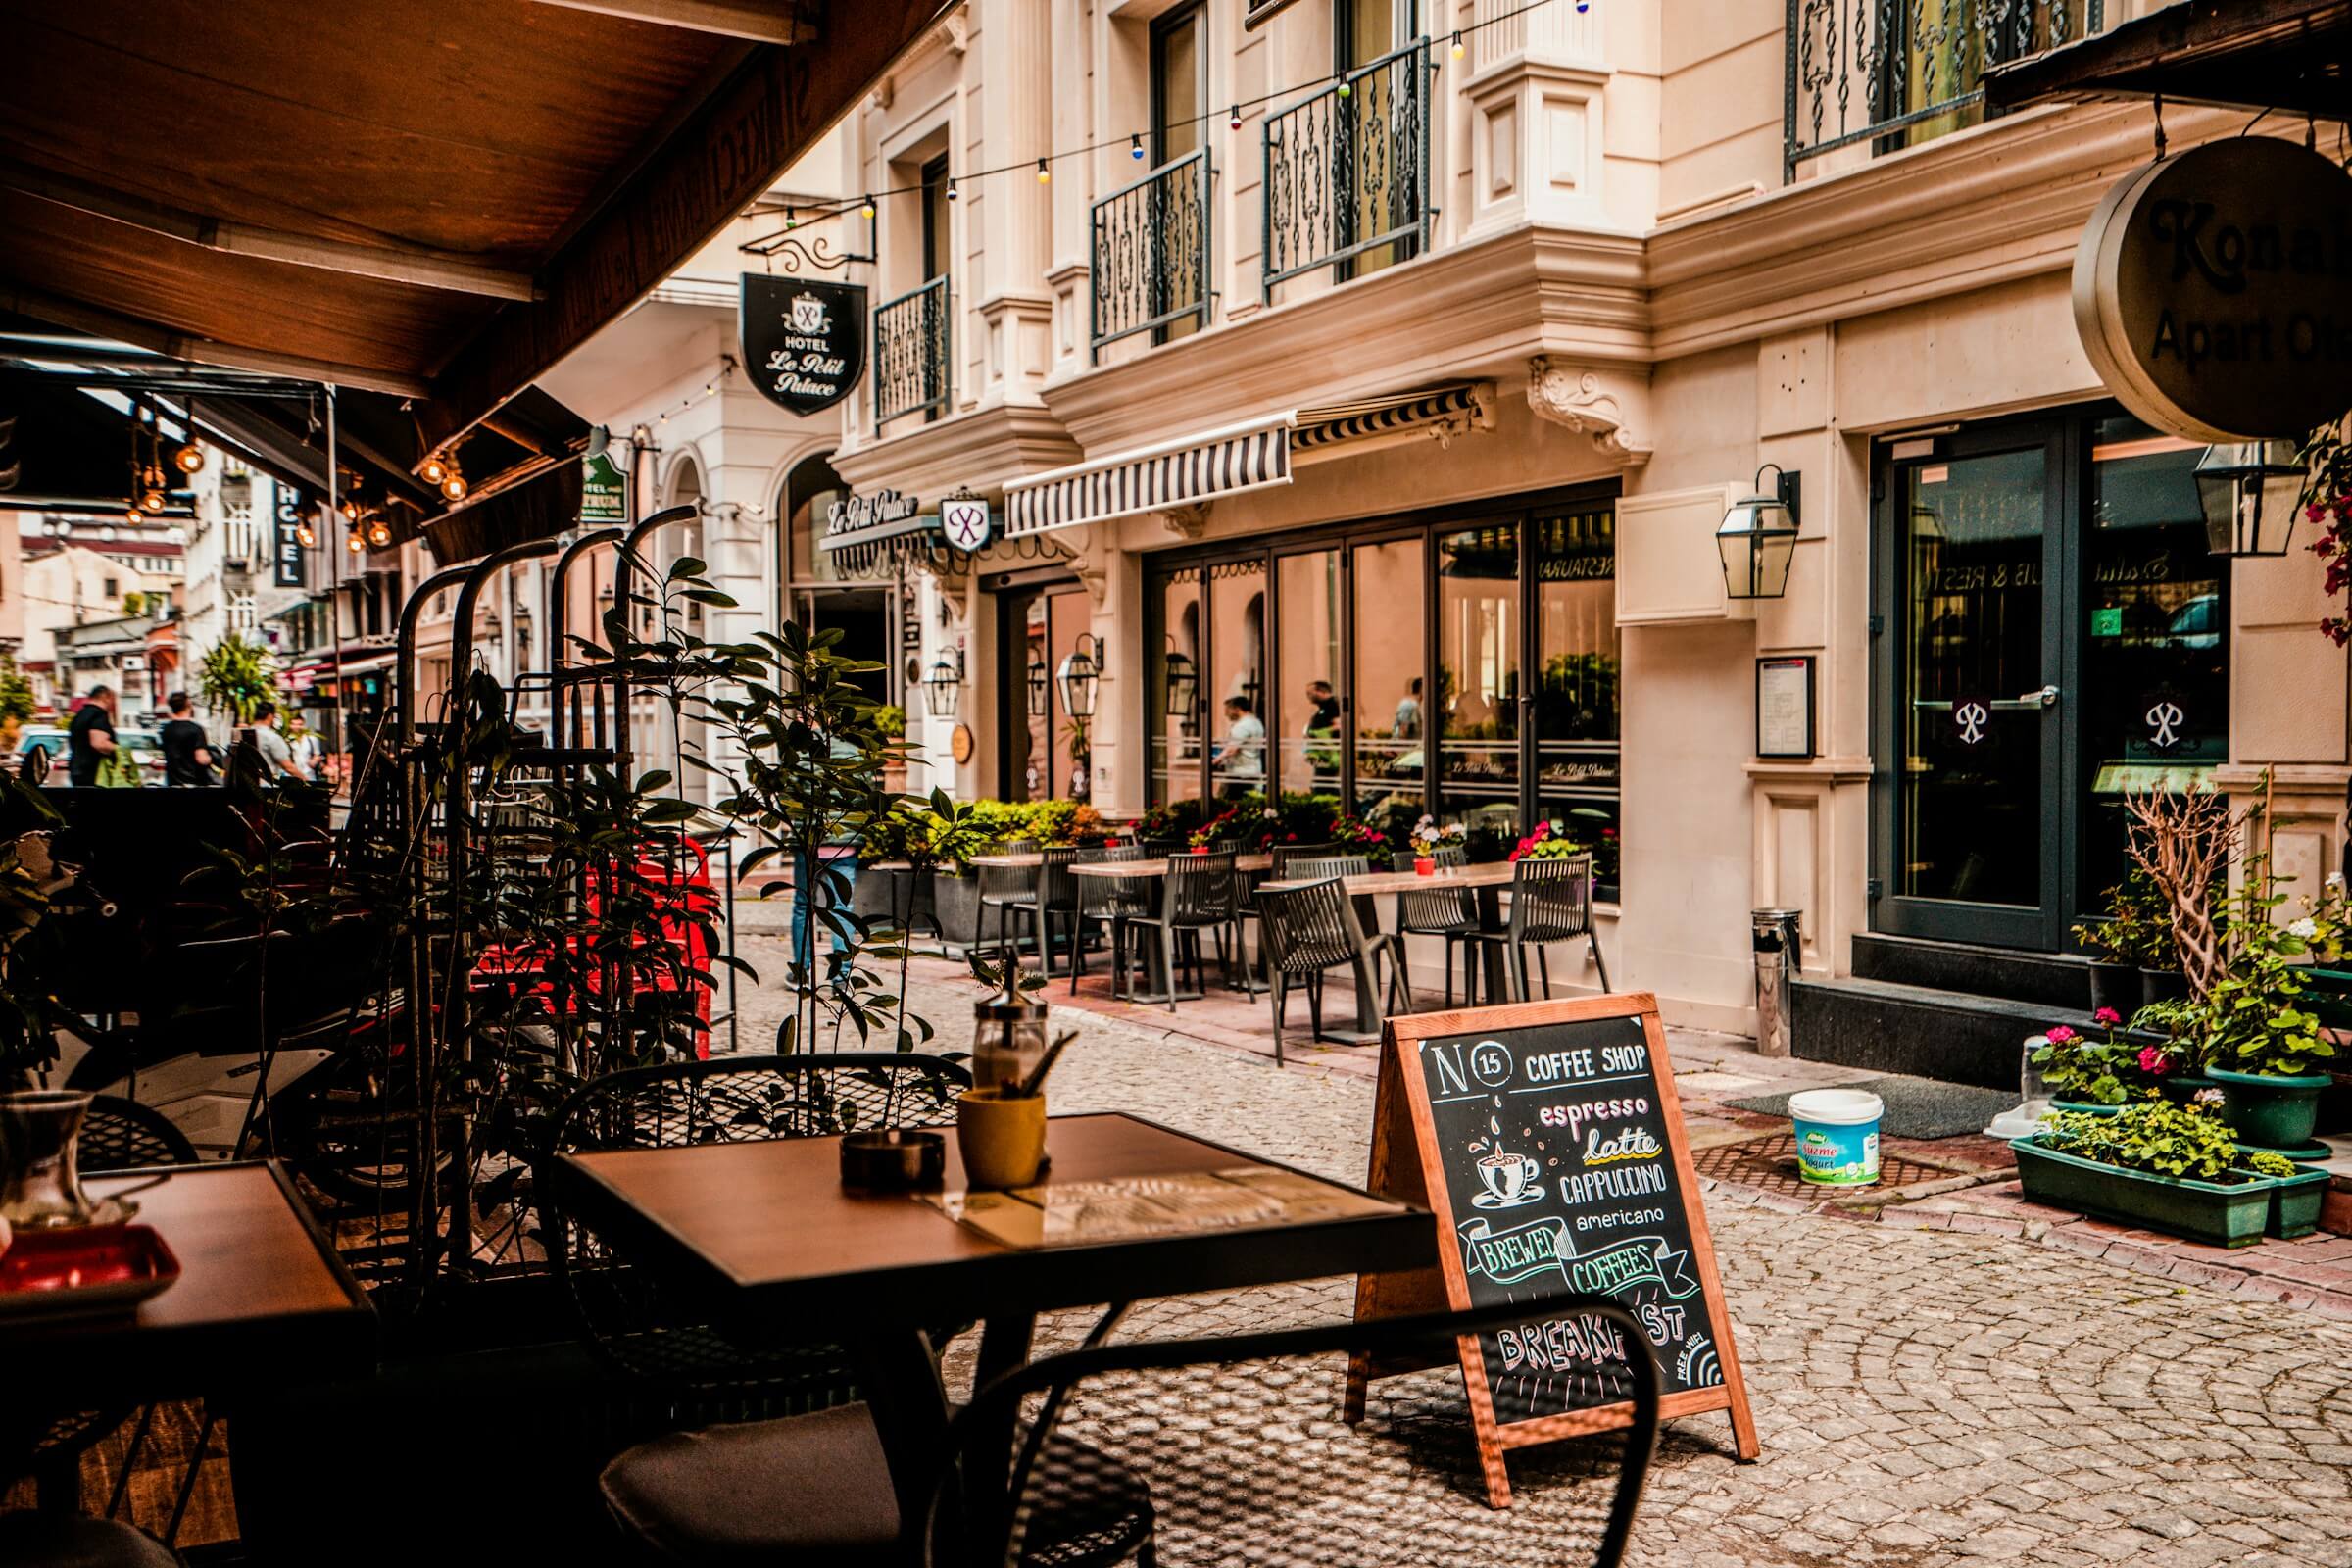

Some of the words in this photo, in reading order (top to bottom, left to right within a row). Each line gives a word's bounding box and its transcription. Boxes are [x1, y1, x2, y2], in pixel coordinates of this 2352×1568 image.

[765, 350, 798, 372] Le
[799, 353, 846, 375] Petit
[785, 335, 831, 353] HOTEL
[2151, 309, 2274, 376] Apart
[773, 372, 837, 397] Palace
[826, 501, 849, 536] Le
[872, 489, 918, 526] Palace
[1551, 762, 1567, 776] Le
[1479, 1053, 1502, 1076] 15
[1525, 1048, 1595, 1083] COFFEE
[1601, 1045, 1647, 1072] SHOP
[1540, 1098, 1649, 1143] espresso
[1582, 1127, 1662, 1166] latte
[1559, 1163, 1667, 1205] CAPPUCCINO
[1576, 1208, 1664, 1231] americano
[1480, 1226, 1558, 1273] BREWED
[1572, 1243, 1654, 1294] COFFEES
[1497, 1303, 1686, 1372] BREAKFST
[1677, 1350, 1688, 1380] FREE
[1685, 1331, 1704, 1350] WIFI
